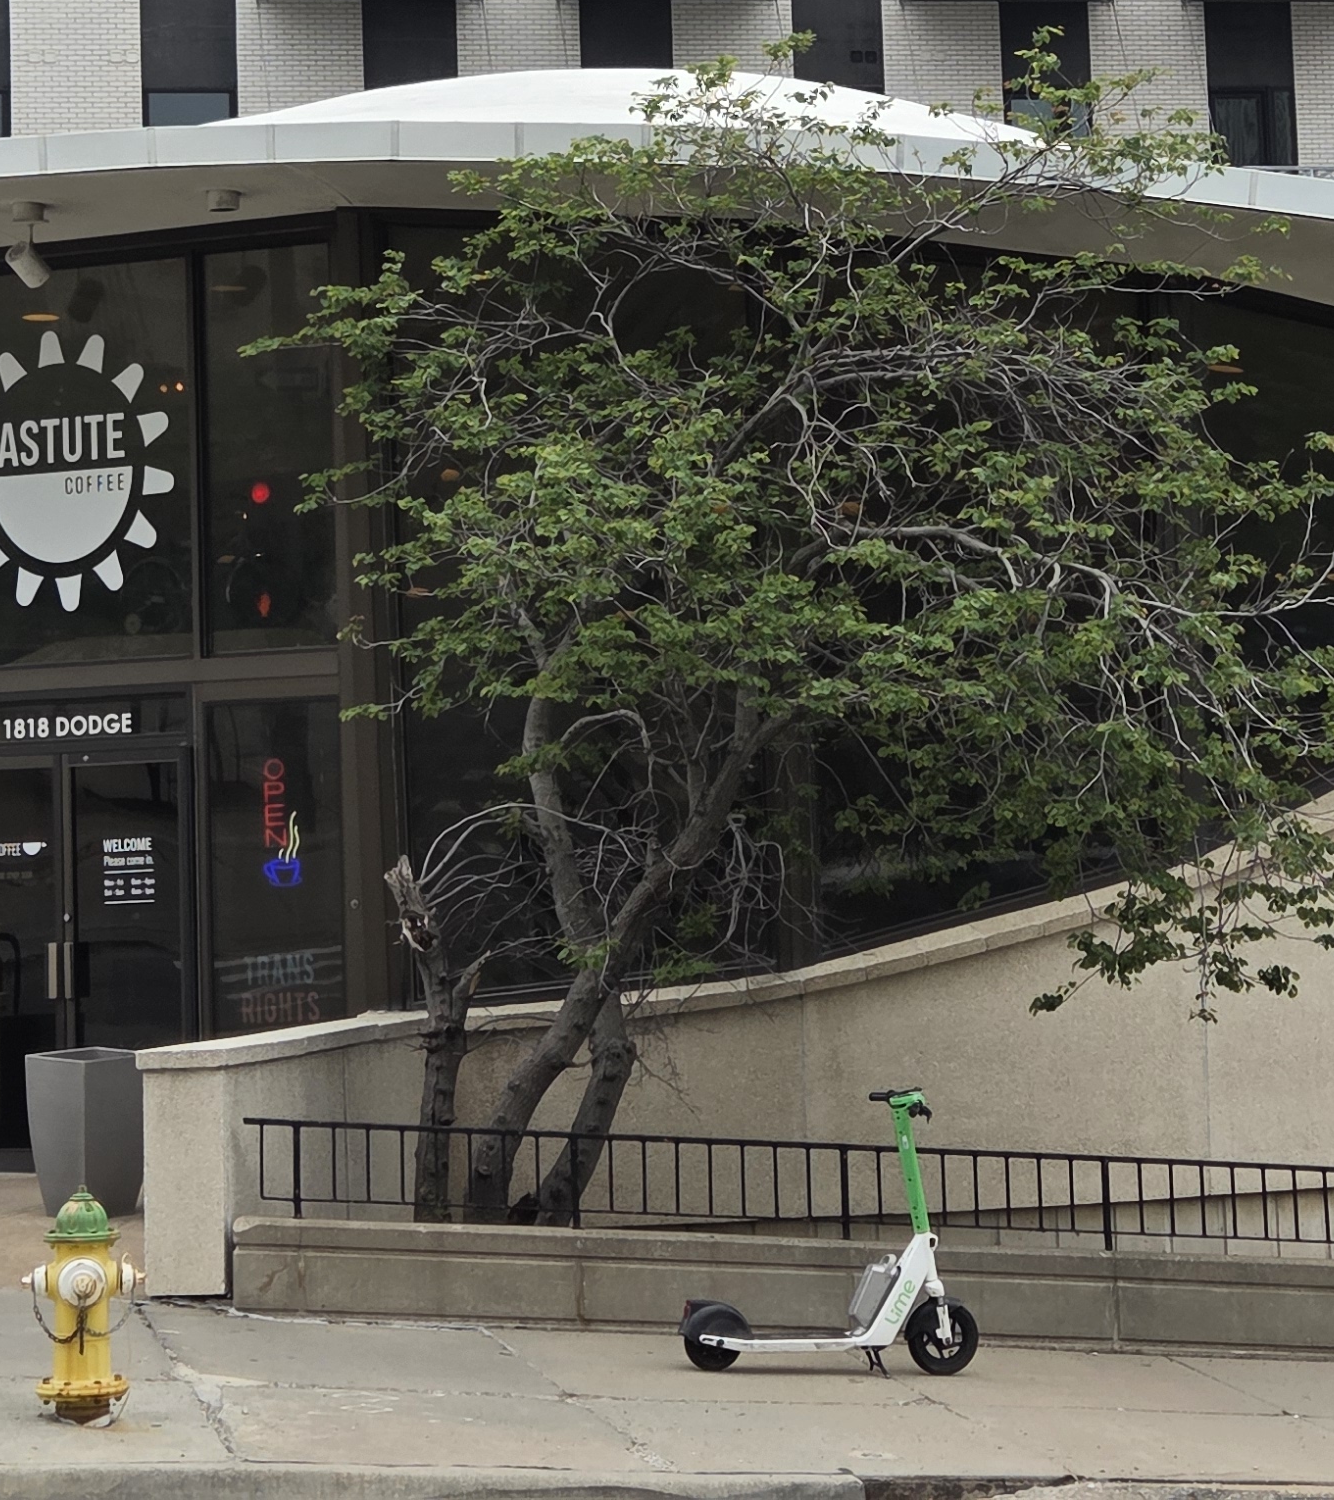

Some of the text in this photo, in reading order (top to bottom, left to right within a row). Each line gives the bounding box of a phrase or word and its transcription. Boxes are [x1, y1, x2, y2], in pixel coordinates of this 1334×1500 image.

[64, 473, 124, 495] COFFEE
[2, 712, 132, 739] 1818 DODGE
[264, 758, 287, 848] OPEN
[103, 837, 152, 853] WELCOME
[243, 952, 315, 986] TRANS
[241, 991, 321, 1024] RIGHTS
[884, 1279, 916, 1325] Lime
